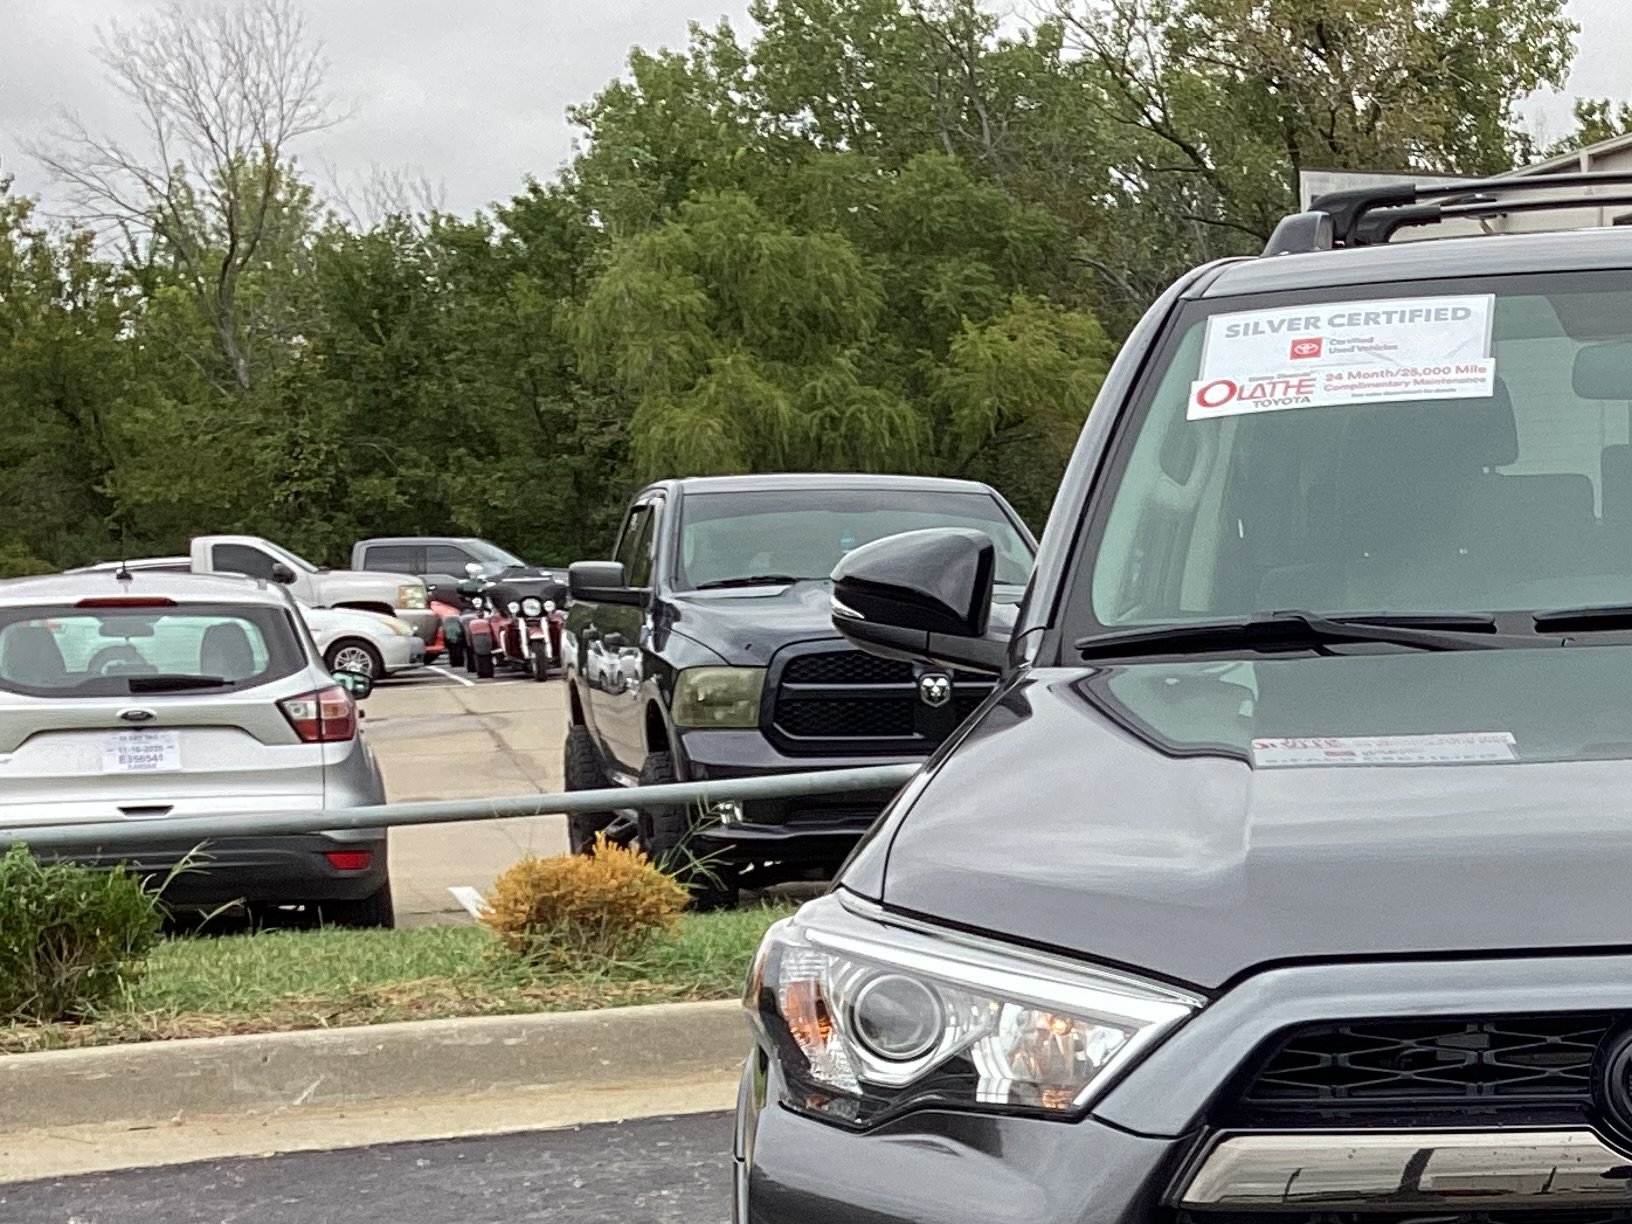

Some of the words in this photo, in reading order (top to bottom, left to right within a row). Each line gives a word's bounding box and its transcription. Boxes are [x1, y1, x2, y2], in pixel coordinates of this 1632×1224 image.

[1225, 315, 1321, 339] SILVER
[1327, 306, 1472, 329] CERTIFIED
[1325, 373, 1344, 382] 24
[1455, 364, 1487, 375] Mile
[1323, 380, 1411, 392] Complimentary
[1413, 376, 1487, 387] Maintenance
[1196, 379, 1317, 408] OLATHE
[1252, 395, 1311, 408] TOYOTA
